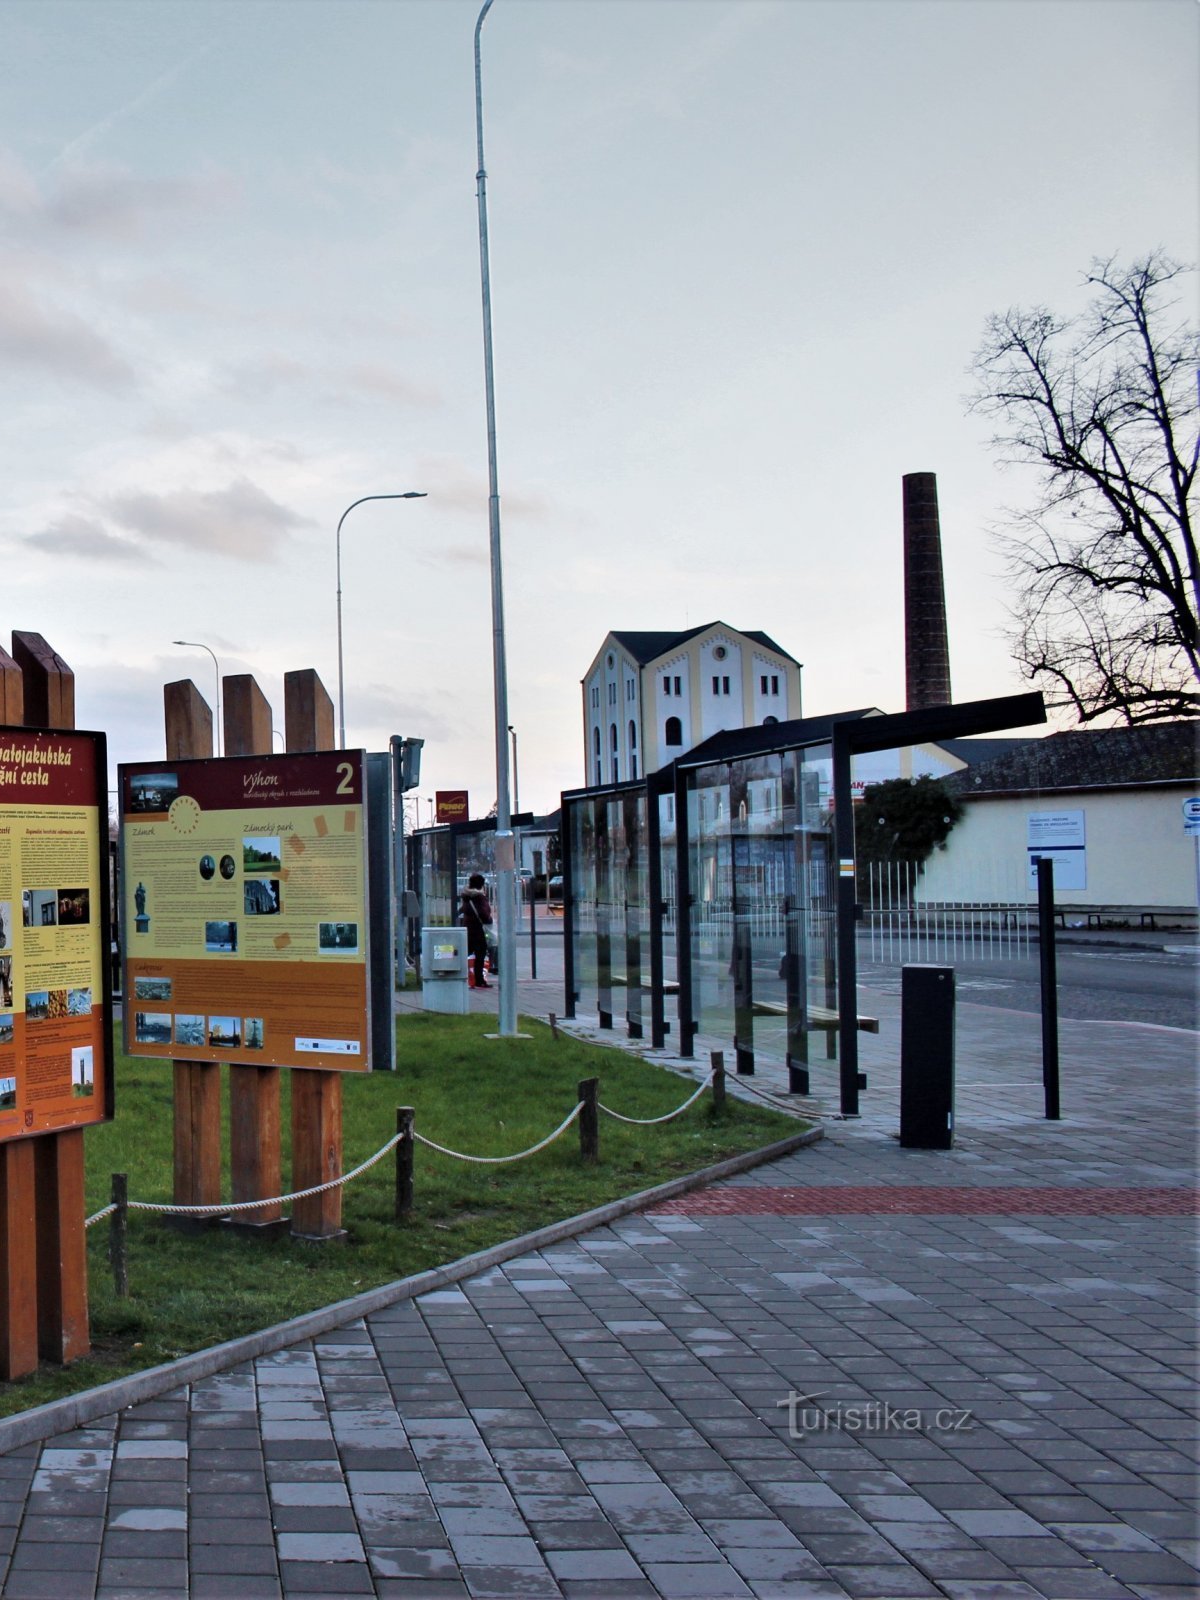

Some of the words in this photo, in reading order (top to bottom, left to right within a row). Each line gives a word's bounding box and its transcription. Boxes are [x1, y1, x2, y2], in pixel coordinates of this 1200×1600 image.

[21, 766, 49, 785] cesta
[243, 770, 278, 794] Výhon
[336, 762, 354, 794] 2
[243, 823, 275, 836] Zámecký
[277, 822, 294, 834] park
